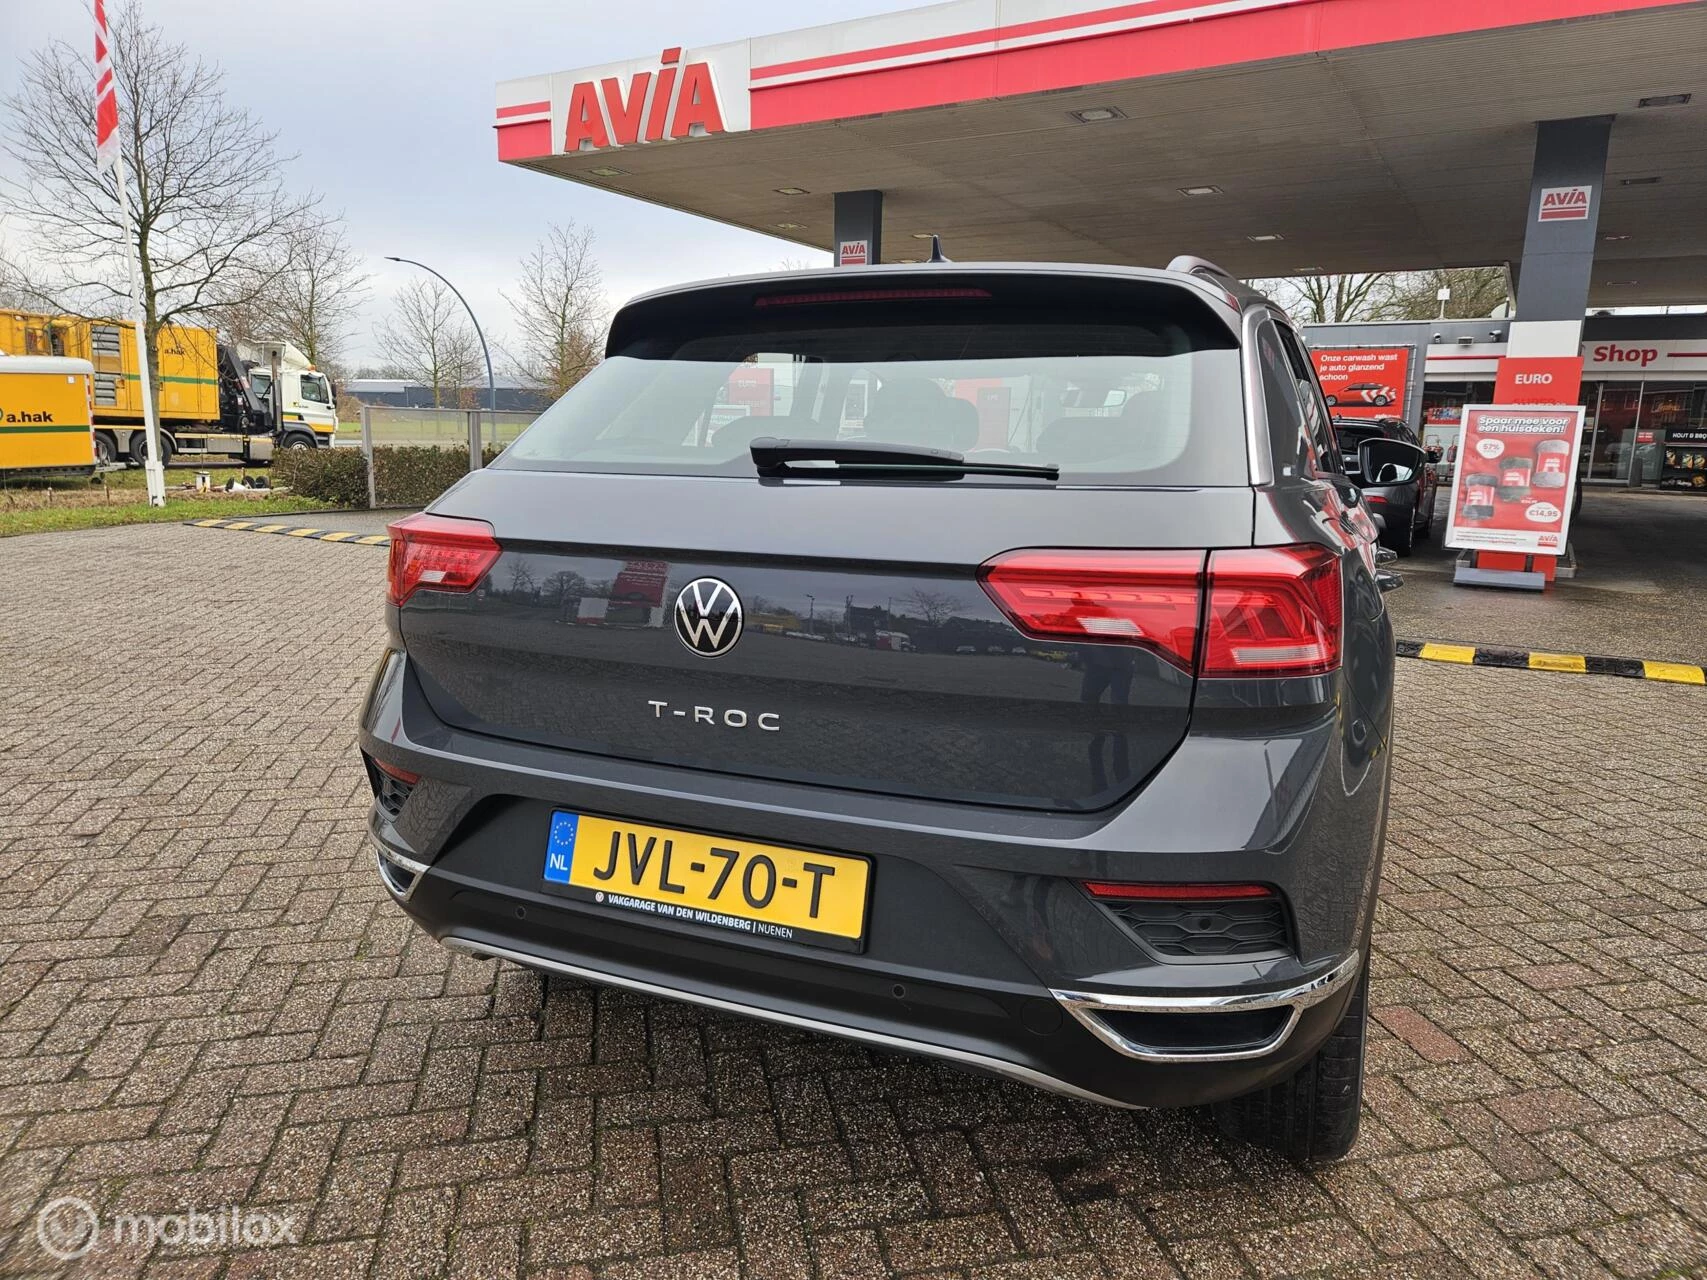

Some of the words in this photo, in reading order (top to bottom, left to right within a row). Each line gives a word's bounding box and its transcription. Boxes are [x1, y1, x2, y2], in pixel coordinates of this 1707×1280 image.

[1378, 353, 1398, 361] wast
[1593, 344, 1658, 367] Shop
[1348, 363, 1385, 373] glanzend
[1319, 373, 1348, 381] schoon
[1515, 373, 1553, 385] EURO
[6, 411, 54, 423] a.hak
[1479, 416, 1511, 426] Spaar
[1541, 418, 1568, 426] voor
[1500, 424, 1565, 433] huisdeken!
[648, 700, 781, 732] T-ROC
[550, 854, 568, 872] NL
[593, 831, 835, 919] JVL-70-T
[608, 893, 656, 912] VAKGARAGE
[657, 903, 675, 915] VAN
[676, 906, 693, 919] DEN
[695, 910, 751, 930] WILDENBERG
[758, 923, 793, 939] NUENEN
